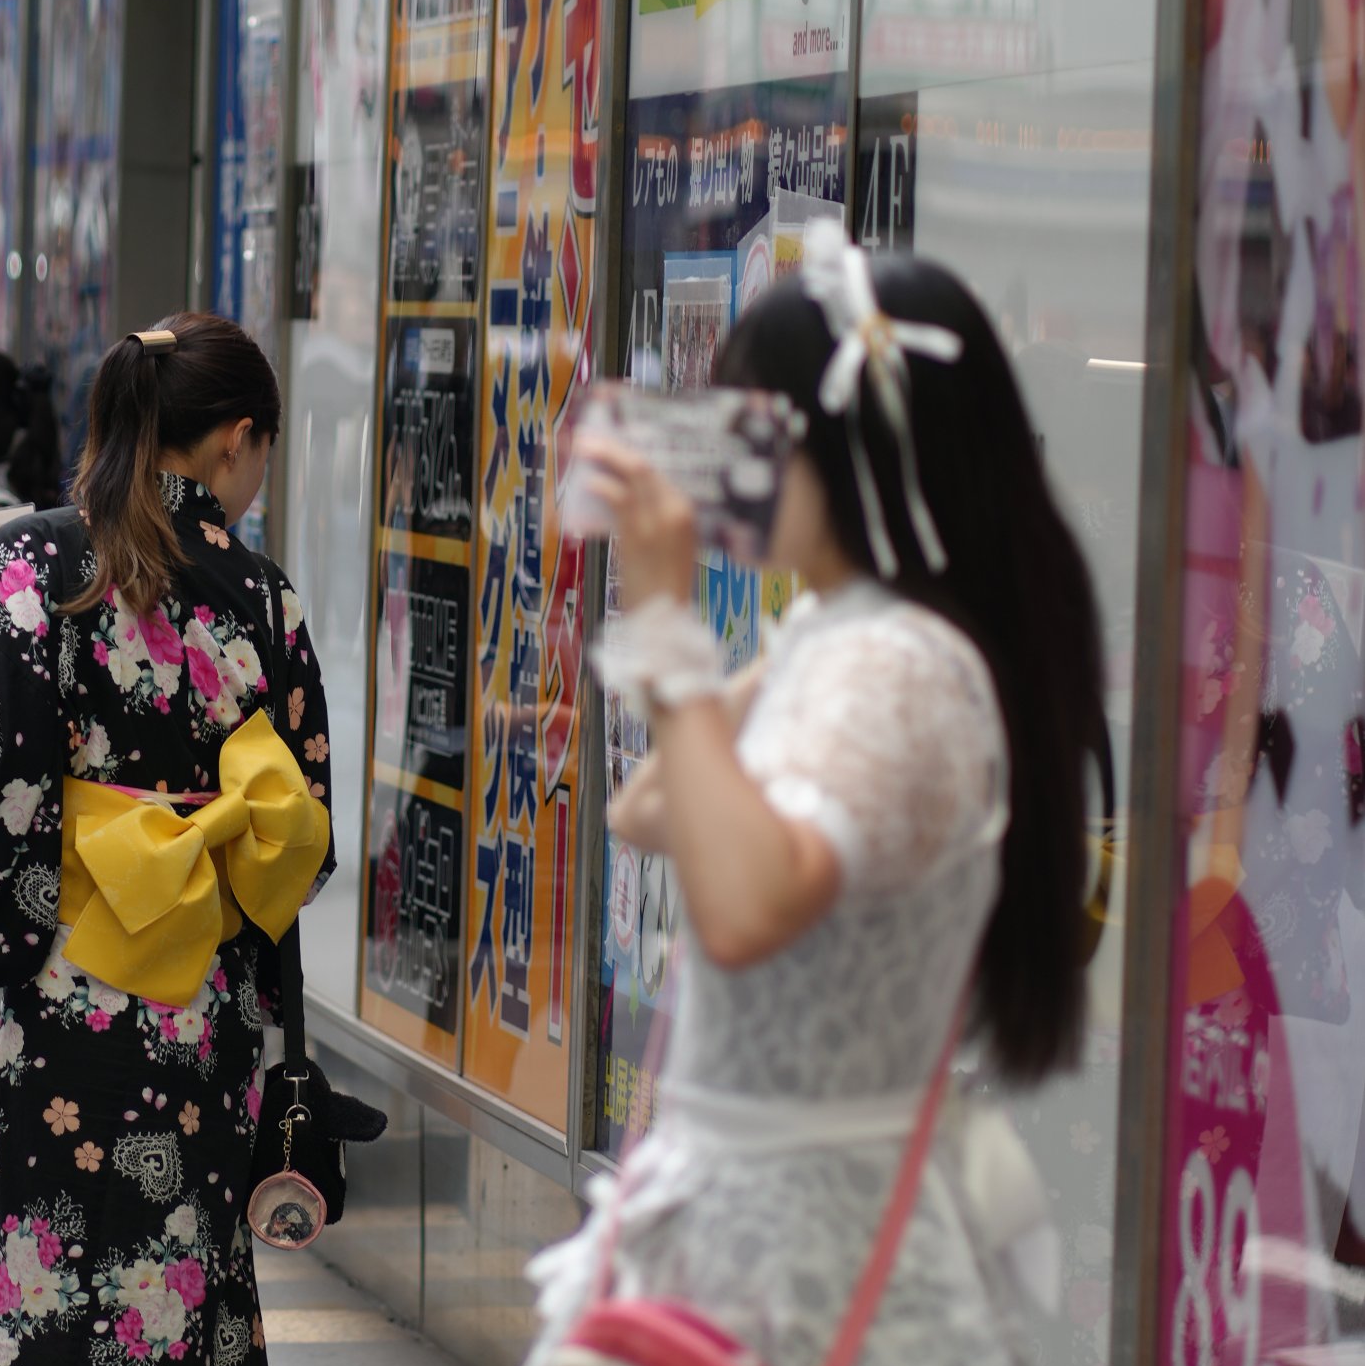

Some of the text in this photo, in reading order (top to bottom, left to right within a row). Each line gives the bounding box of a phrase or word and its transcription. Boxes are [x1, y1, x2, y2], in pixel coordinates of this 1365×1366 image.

[792, 20, 808, 56] and
[634, 121, 841, 209] レアもの 掘り出し物 続々出品中
[860, 133, 910, 253] 4F
